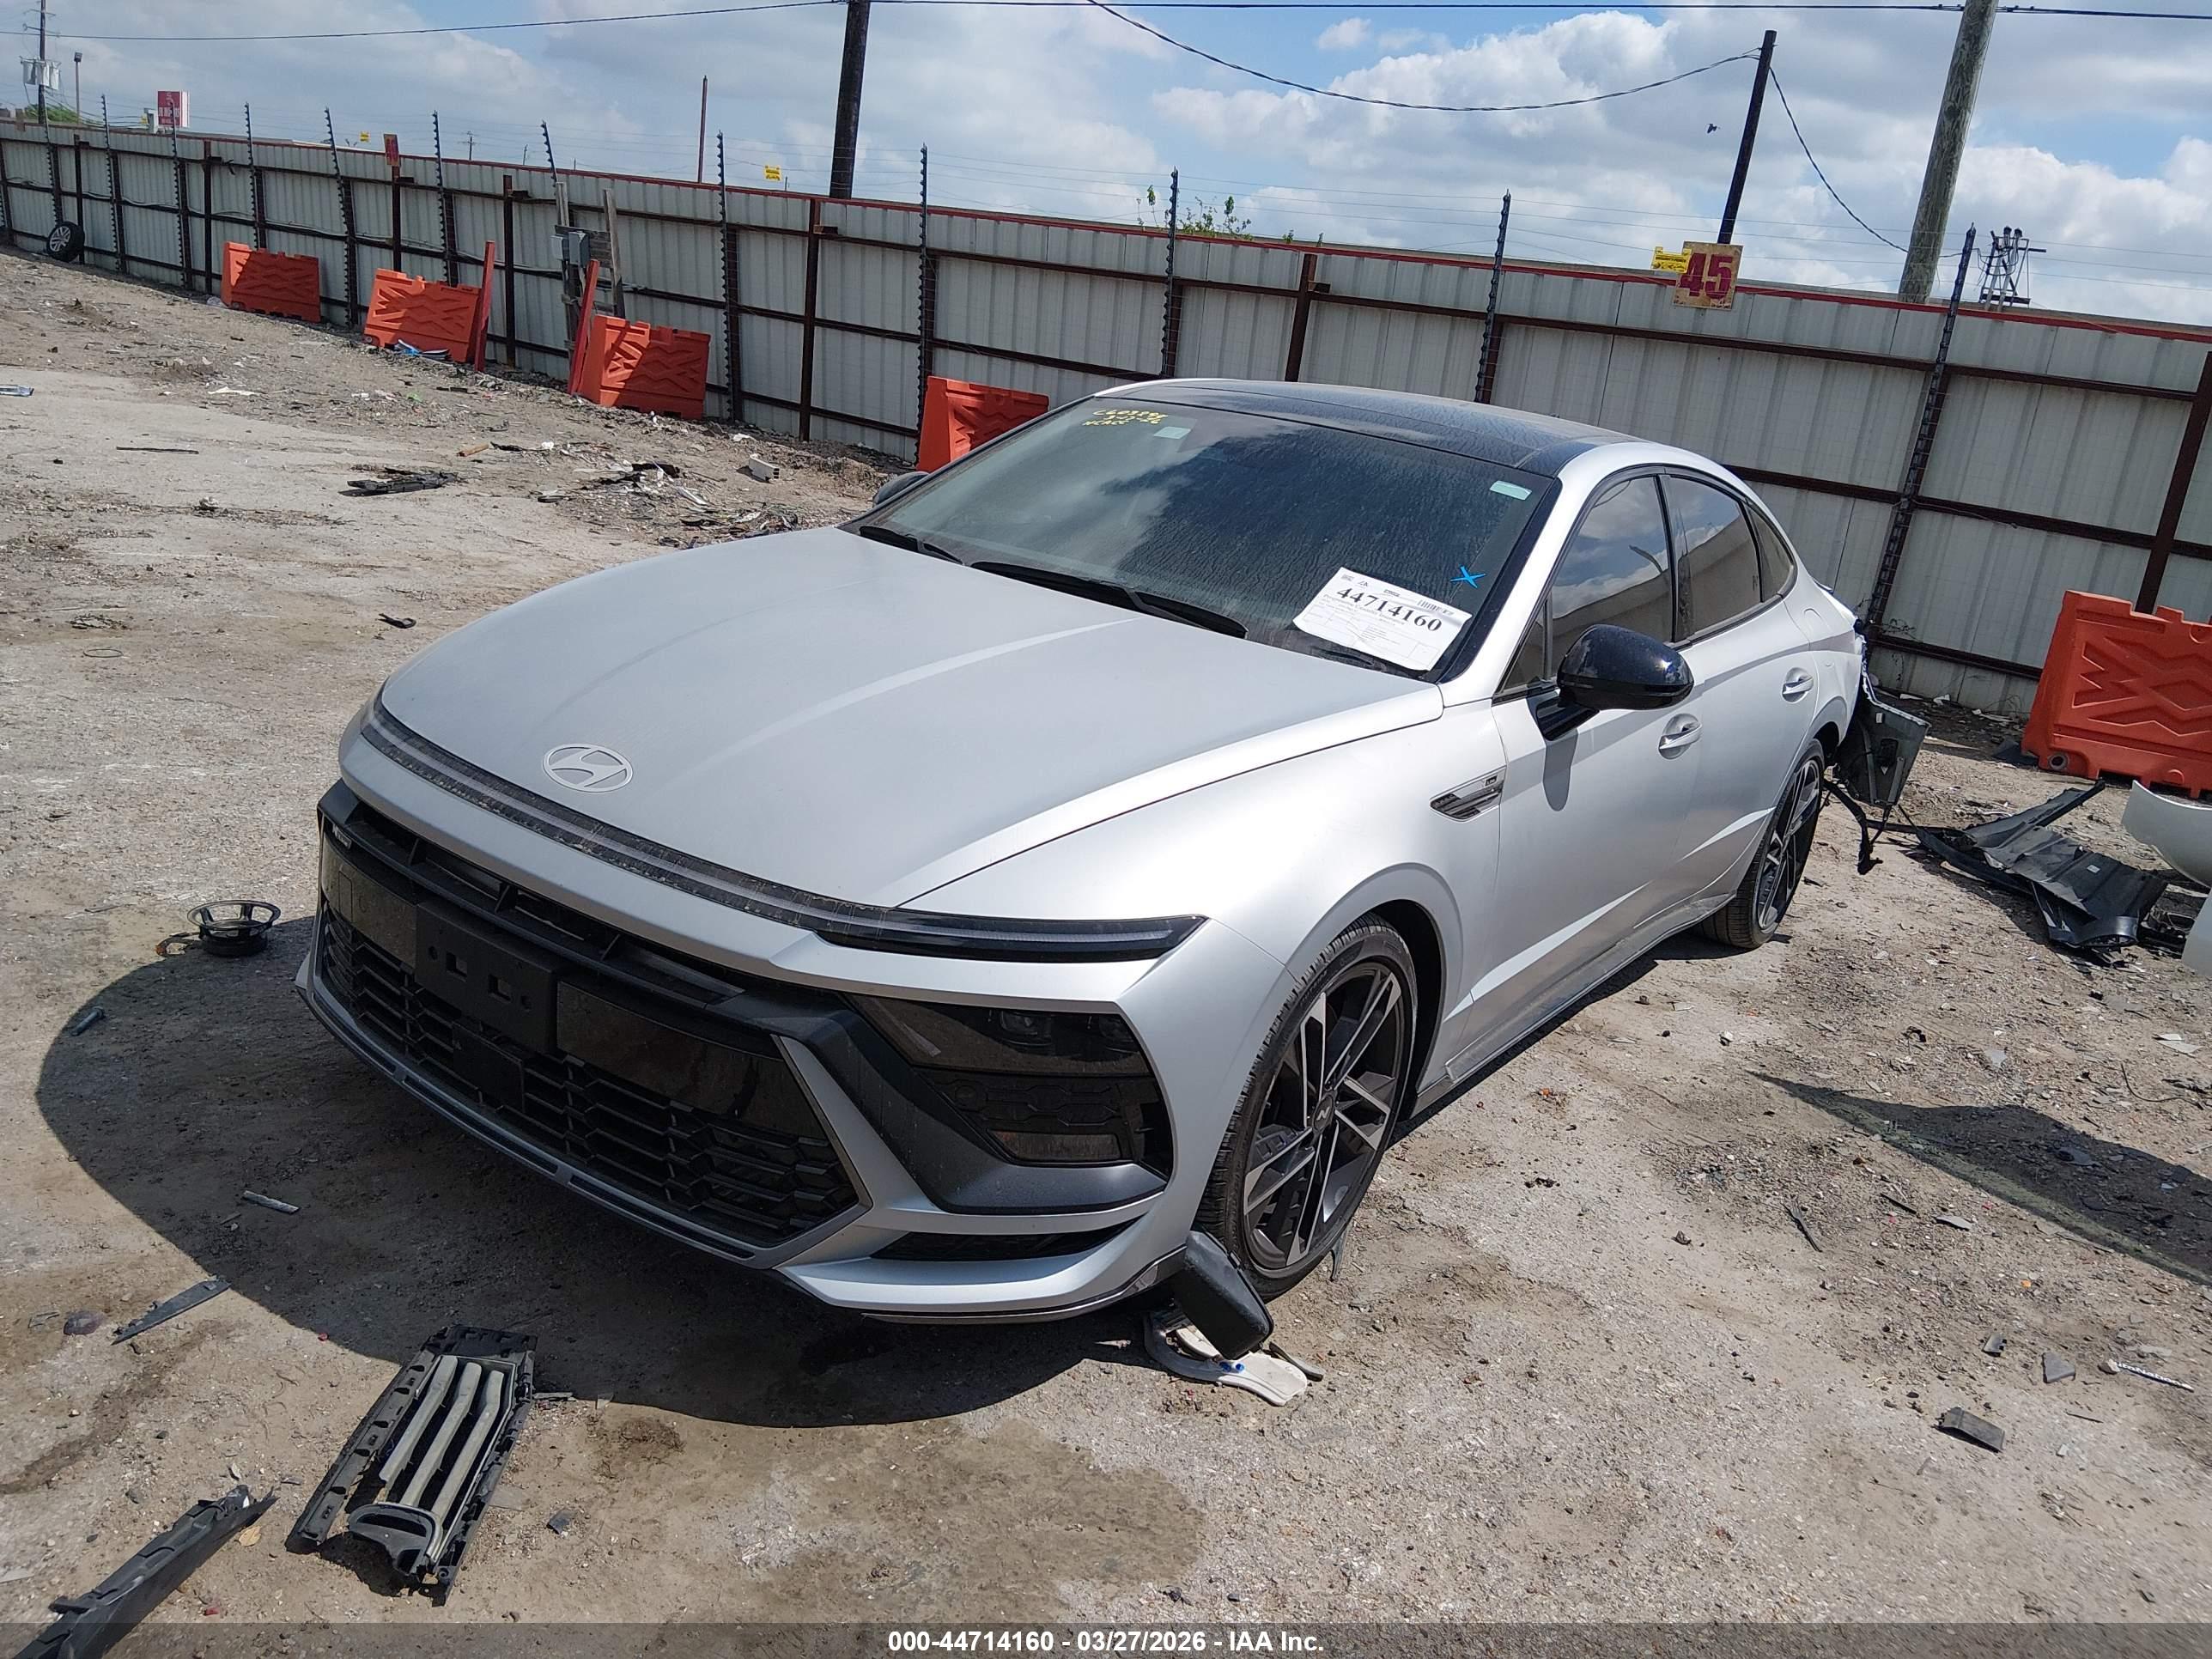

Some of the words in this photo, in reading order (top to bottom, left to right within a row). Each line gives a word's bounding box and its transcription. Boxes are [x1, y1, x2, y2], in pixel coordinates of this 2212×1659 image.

[1680, 252, 1733, 300] 45
[1336, 587, 1443, 631] 44714160
[1316, 1106, 1330, 1121] N
